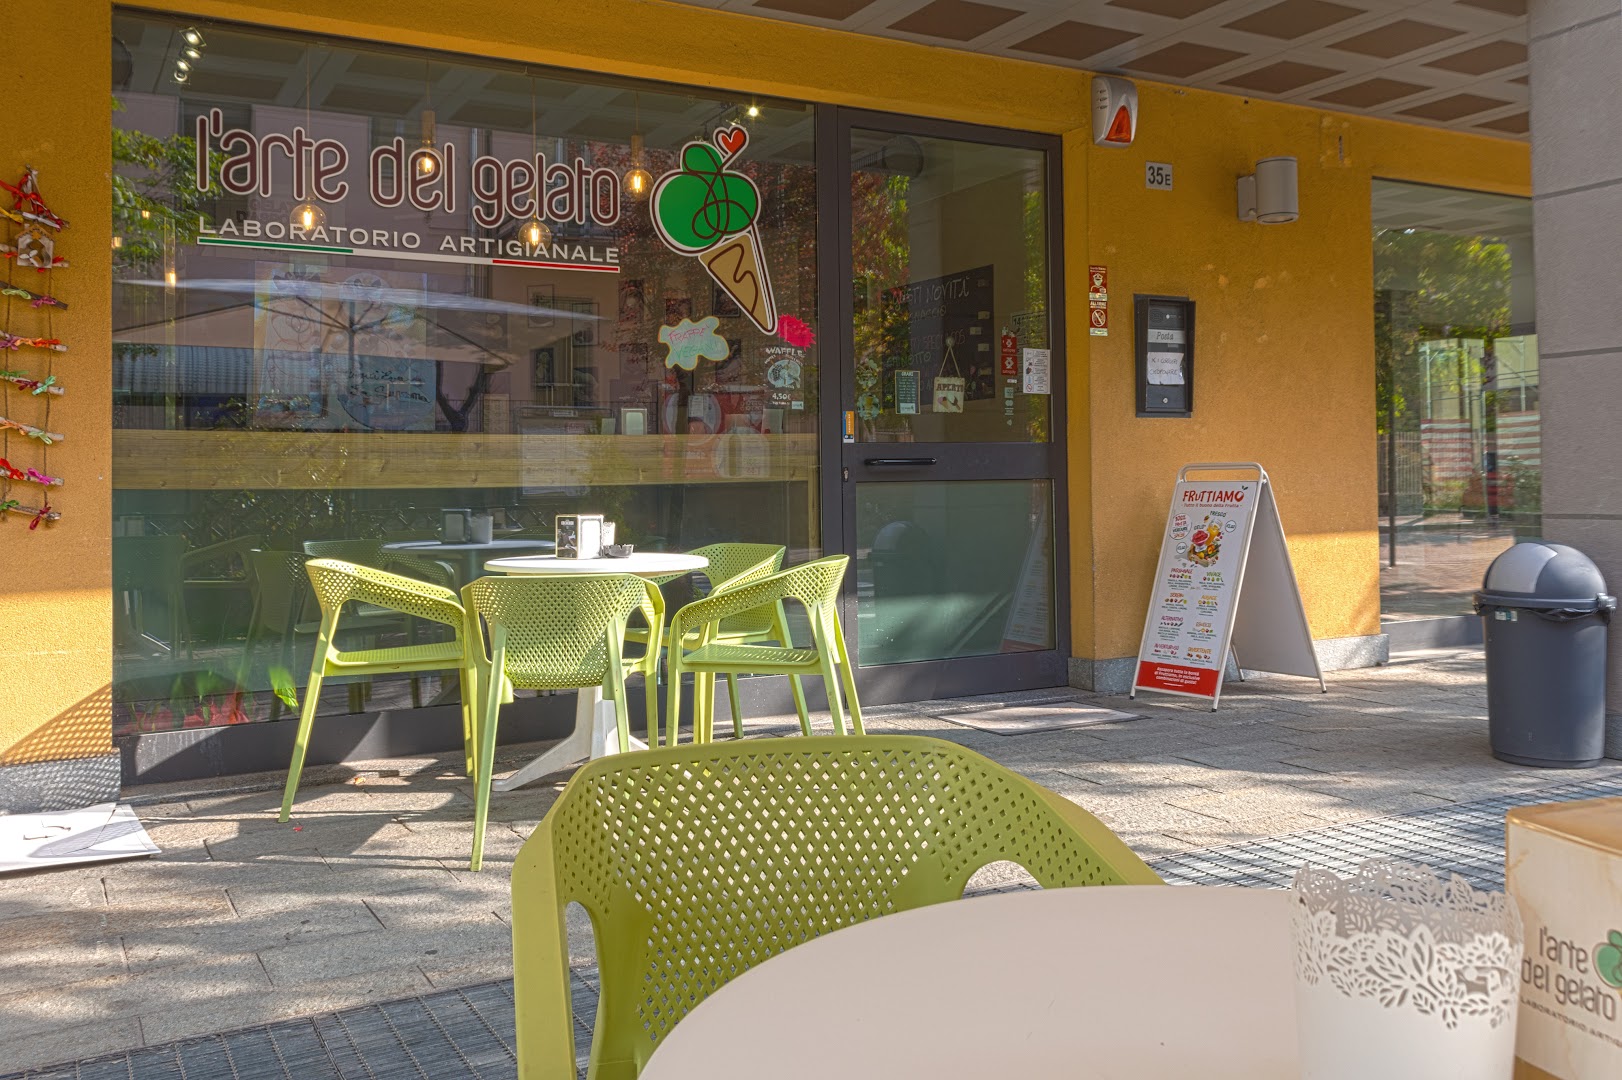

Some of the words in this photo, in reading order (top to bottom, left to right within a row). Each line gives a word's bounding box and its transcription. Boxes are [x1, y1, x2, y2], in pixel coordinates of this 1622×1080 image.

[196, 107, 349, 203] l'arte
[370, 136, 456, 213] del
[472, 152, 620, 229] gelato
[199, 216, 421, 248] LABORATORIO
[439, 235, 620, 263] ARTIGIANALE
[1156, 331, 1174, 340] Posta
[1539, 926, 1588, 975] l'arte
[1521, 956, 1549, 993] del
[1555, 973, 1617, 1021] gelato
